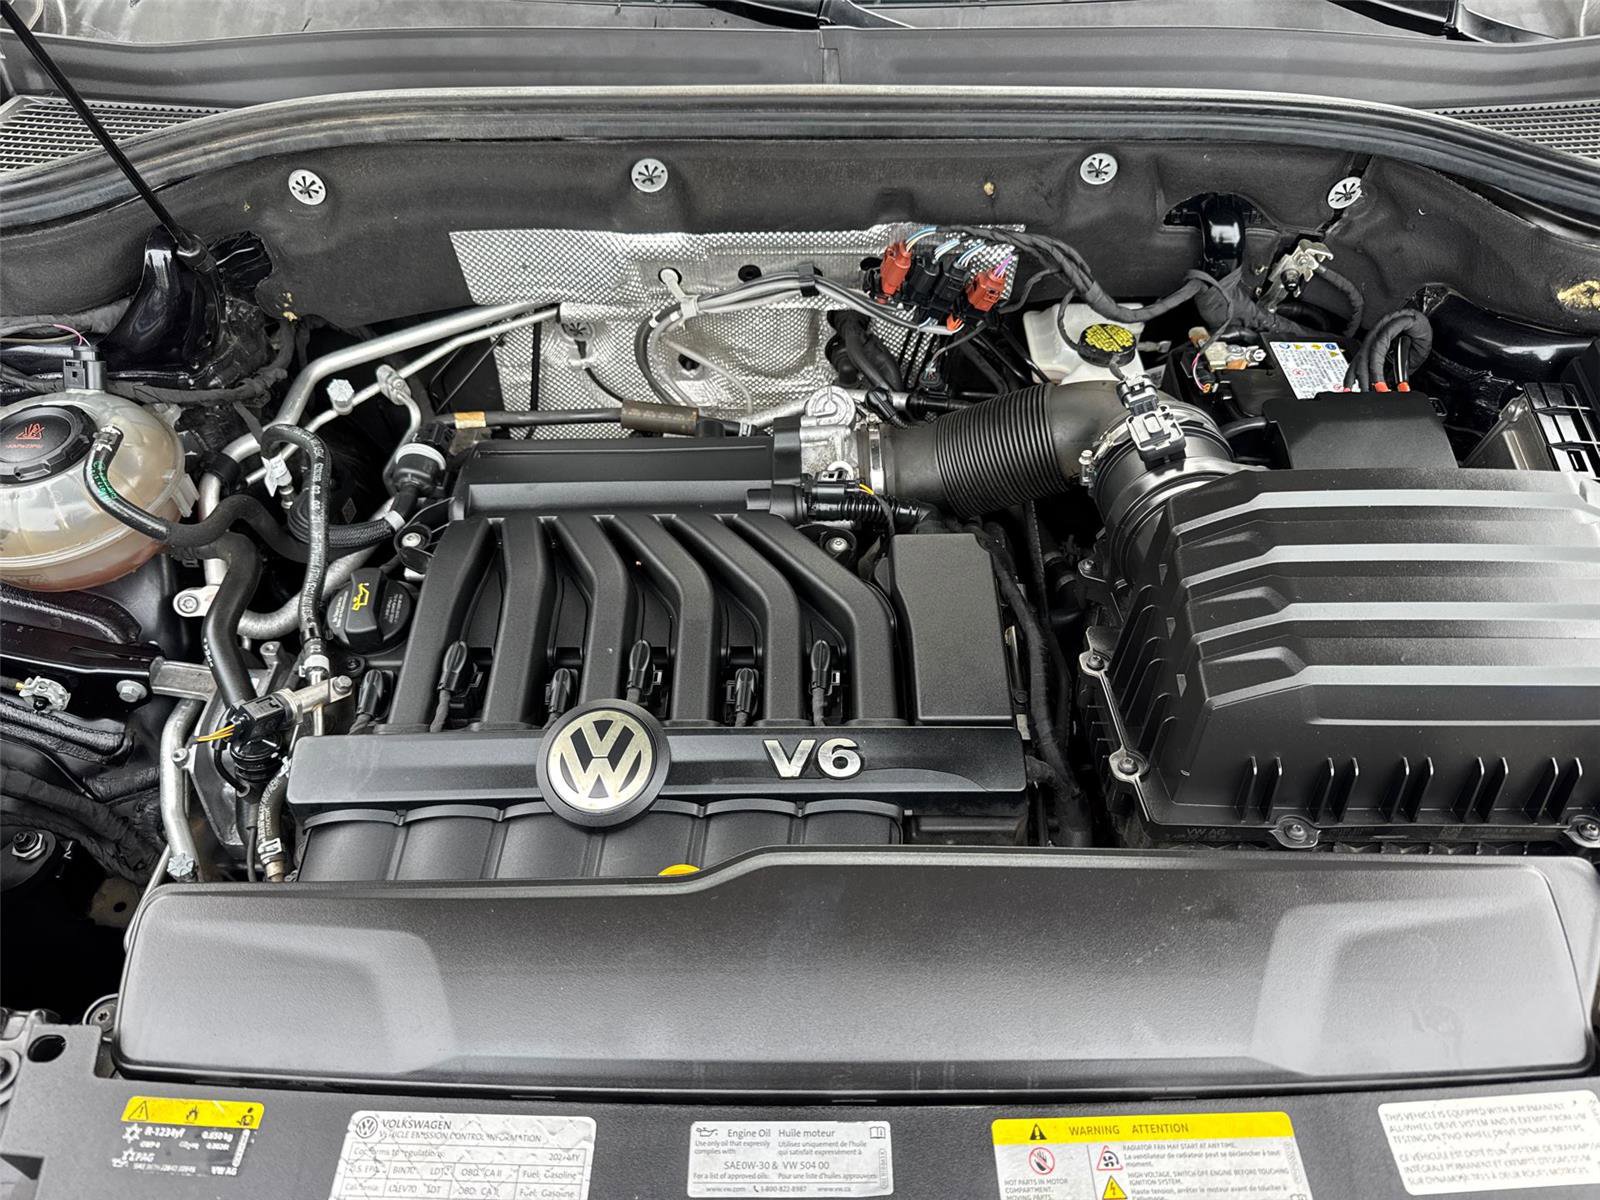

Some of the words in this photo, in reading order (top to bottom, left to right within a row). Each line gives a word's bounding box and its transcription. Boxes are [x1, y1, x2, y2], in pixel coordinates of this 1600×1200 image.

[763, 738, 864, 780] V6
[1385, 1113, 1403, 1122] THIS
[1404, 1111, 1436, 1120] VEHICLE
[383, 1119, 452, 1130] VOLKSWAGEN
[1069, 1125, 1120, 1136] WARNING
[1132, 1123, 1189, 1134] ATTENTION
[728, 1129, 757, 1140] Engine
[758, 1129, 771, 1138] Oil
[778, 1129, 801, 1138] Huile
[803, 1129, 836, 1138] moteur
[707, 1140, 720, 1148] only
[743, 1140, 770, 1148] expressly
[1133, 1152, 1165, 1160] ventilateur
[772, 1161, 778, 1169] &
[783, 1161, 798, 1170] VW
[800, 1161, 816, 1170] 504
[818, 1162, 830, 1170] 00
[1174, 1170, 1196, 1178] SWITCH
[1210, 1169, 1233, 1177] ENGINE
